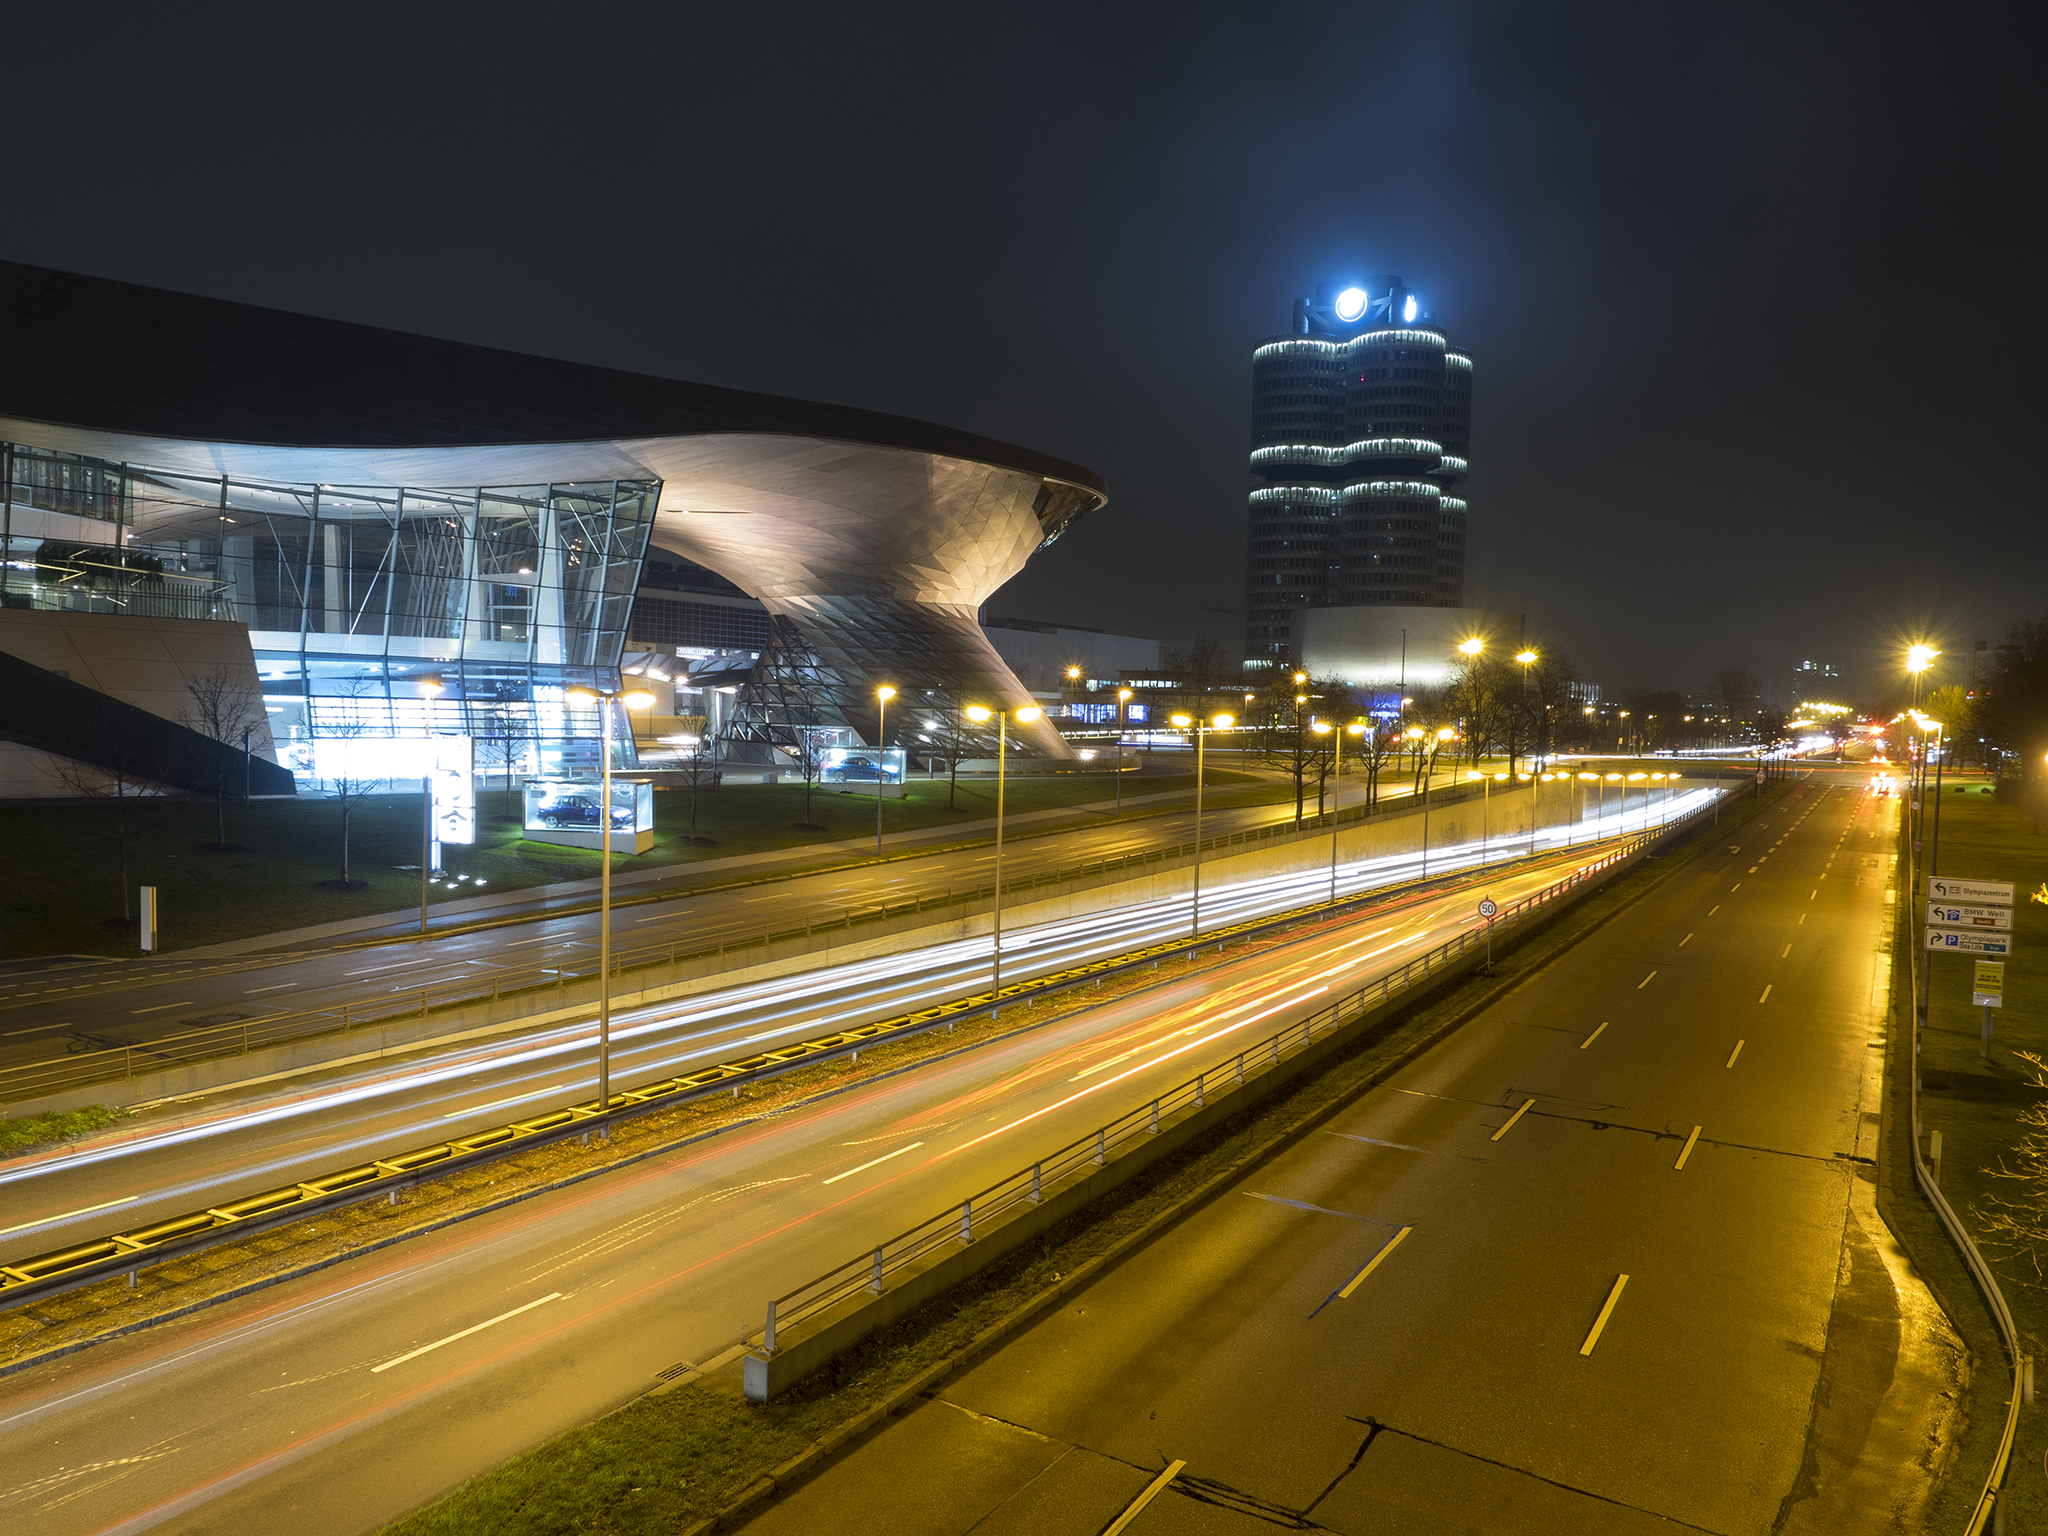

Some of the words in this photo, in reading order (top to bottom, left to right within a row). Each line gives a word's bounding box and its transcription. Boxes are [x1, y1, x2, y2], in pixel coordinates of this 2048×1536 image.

[1963, 888, 2010, 897] Olympiazentrum
[1482, 904, 1493, 913] 50
[1964, 908, 1984, 916] BMW
[1960, 934, 2007, 944] Olympiapark
